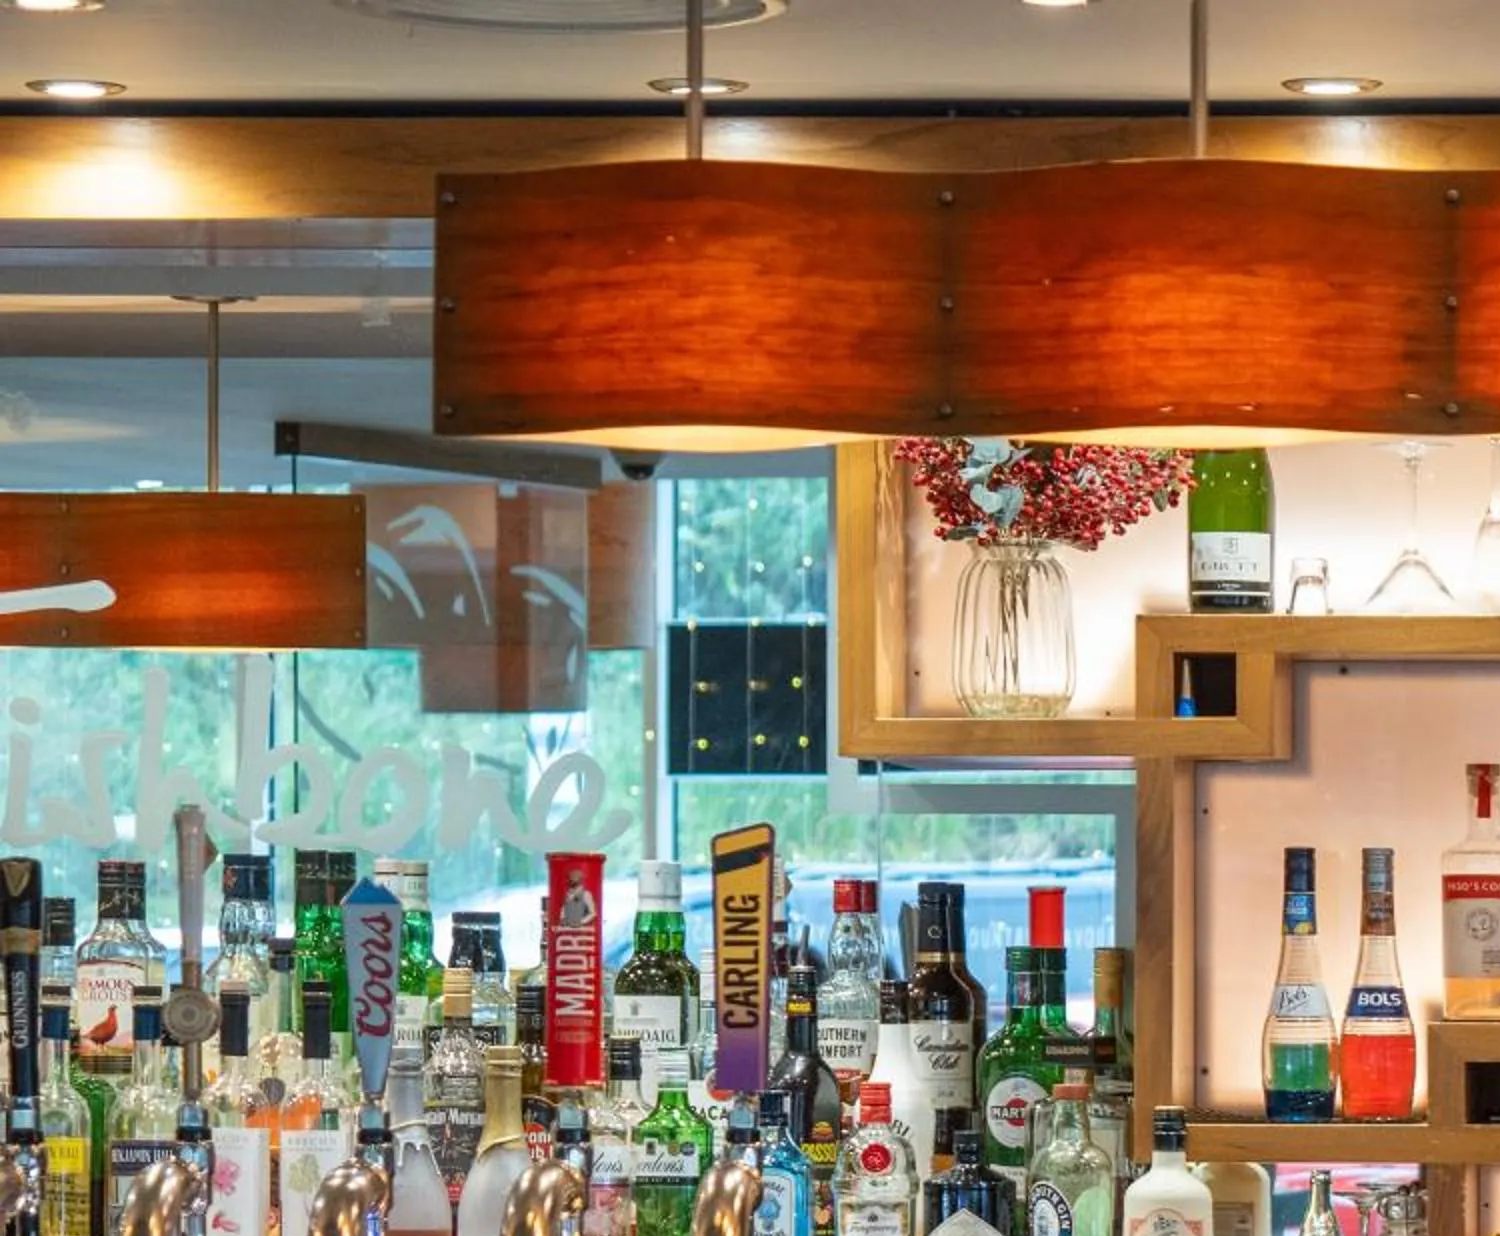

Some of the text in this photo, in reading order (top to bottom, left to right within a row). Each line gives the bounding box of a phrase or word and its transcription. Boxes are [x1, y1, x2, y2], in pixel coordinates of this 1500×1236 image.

[0, 654, 634, 852] ishbone
[355, 911, 394, 1037] Coors
[723, 893, 761, 1029] CARLING
[1357, 991, 1402, 1007] BOLS
[12, 970, 29, 1048] GUINNESS
[816, 1028, 867, 1041] OUTHERN
[818, 1045, 863, 1058] OMFORT
